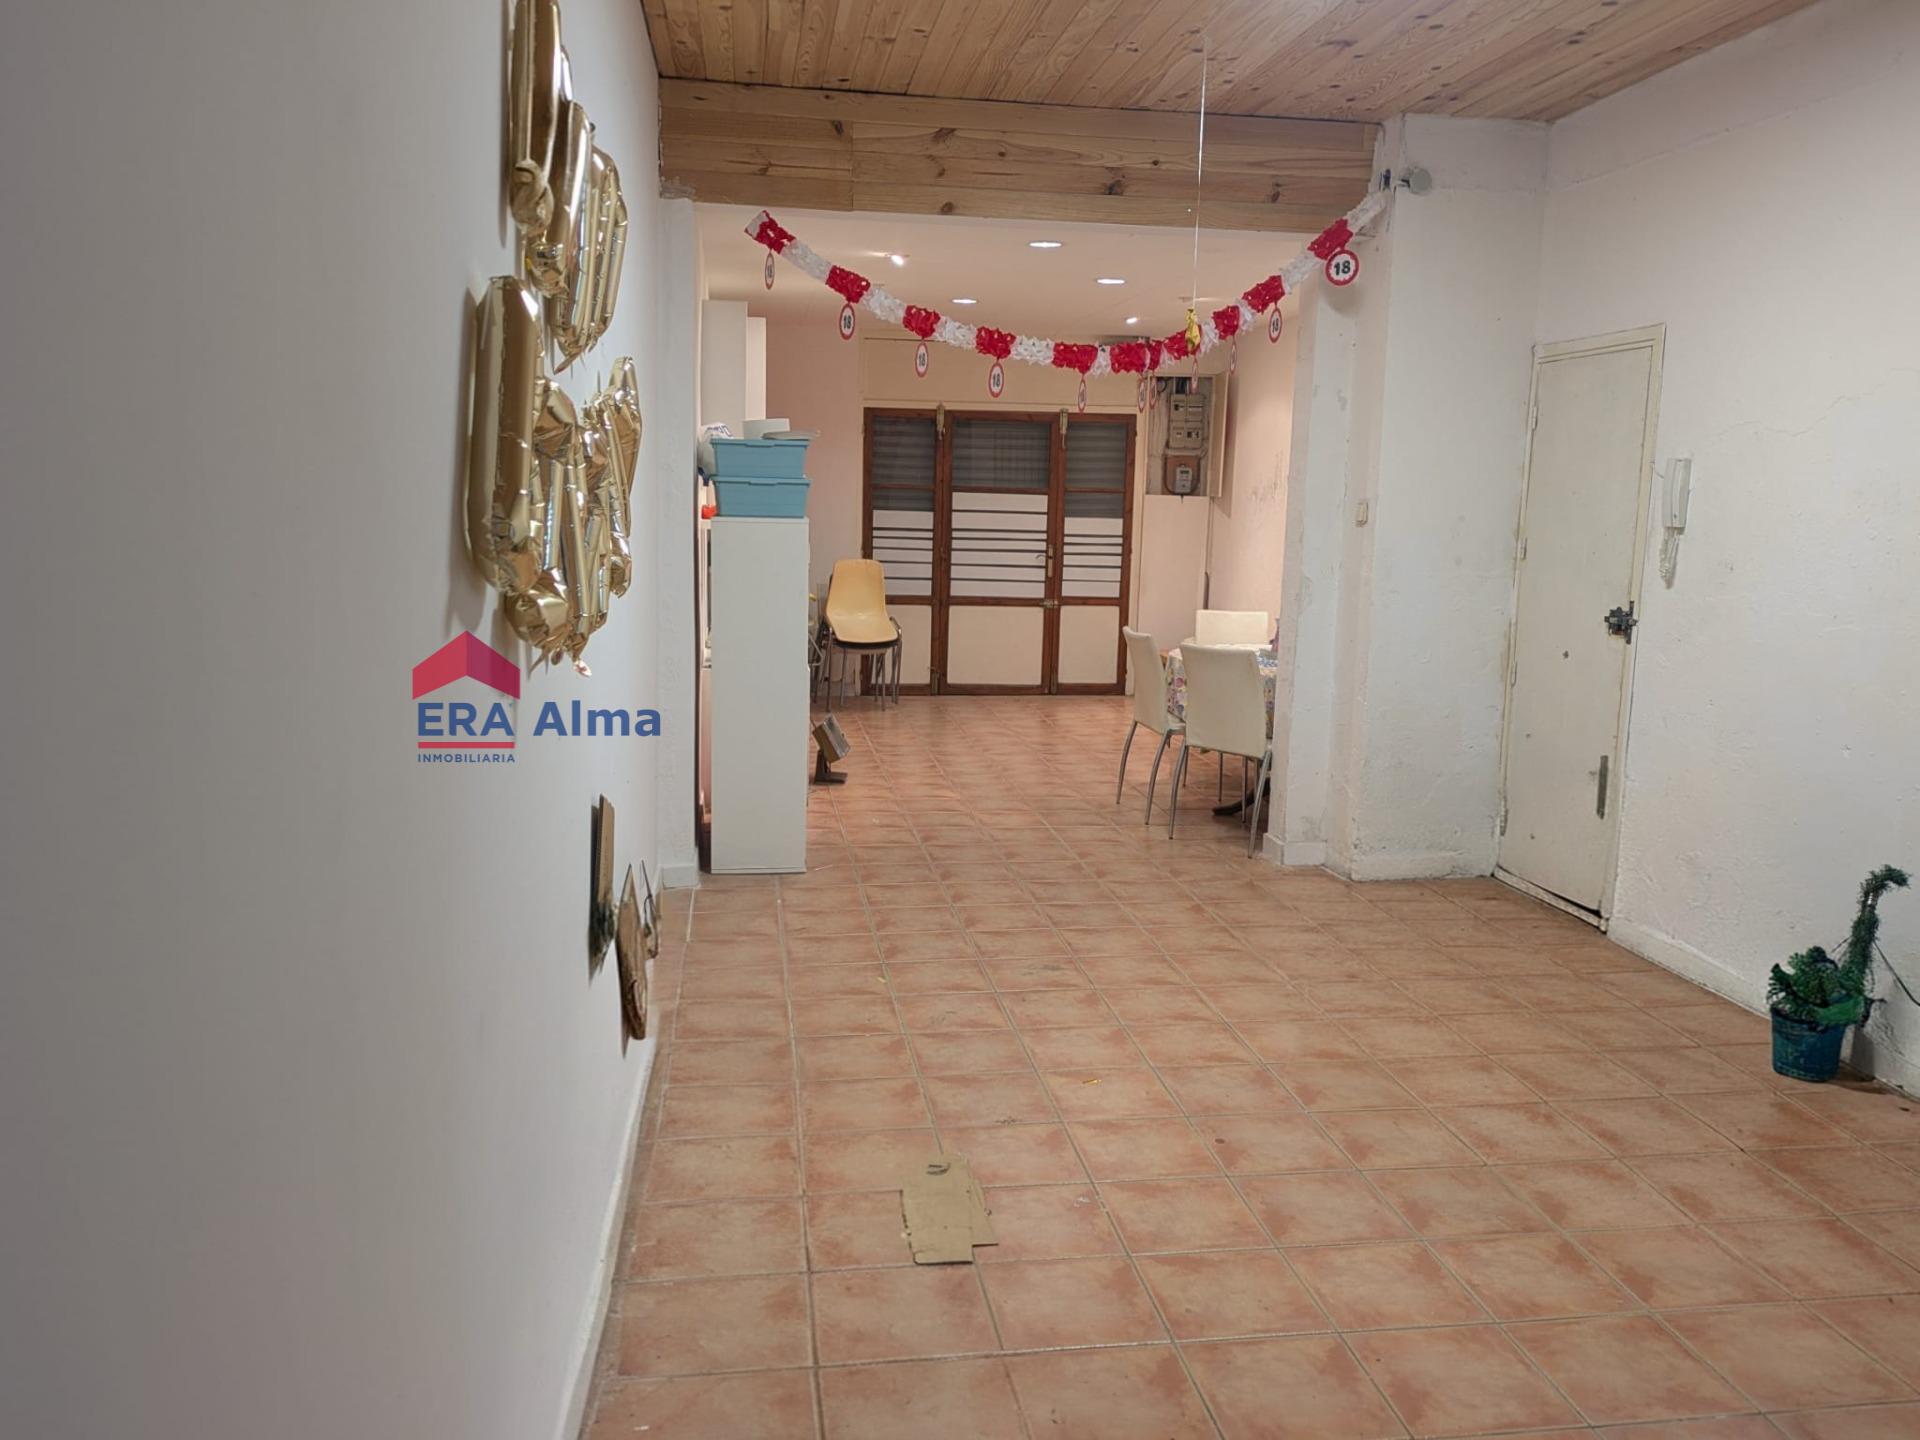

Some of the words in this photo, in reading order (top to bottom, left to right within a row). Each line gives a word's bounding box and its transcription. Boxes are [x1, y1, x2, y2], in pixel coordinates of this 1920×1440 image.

[1334, 260, 1351, 276] 18
[843, 314, 852, 330] 18
[992, 373, 1001, 388] 18
